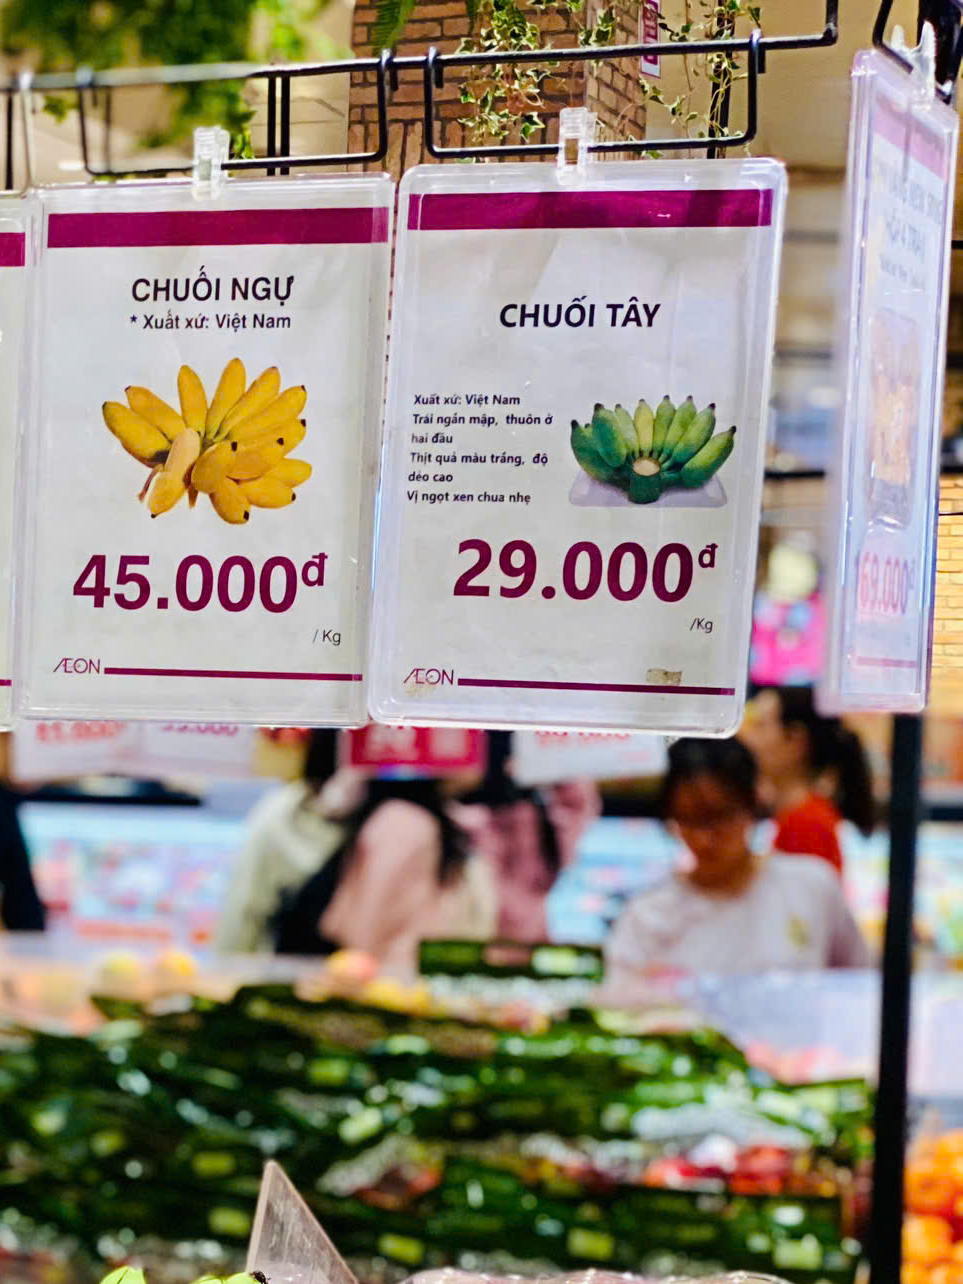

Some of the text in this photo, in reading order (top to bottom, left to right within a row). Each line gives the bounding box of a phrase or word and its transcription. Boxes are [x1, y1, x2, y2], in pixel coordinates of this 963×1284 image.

[132, 266, 294, 306] CHUỐI NGỰ
[499, 296, 661, 328] CHUỐI TÂY
[142, 309, 179, 329] Xuất
[185, 314, 209, 329] xứ:
[215, 313, 246, 333] Việt
[253, 314, 291, 328] Nam
[413, 394, 440, 405] Xuất
[465, 394, 489, 407] Việt
[492, 395, 521, 405] Nam
[413, 413, 433, 424] Trái
[469, 413, 498, 427] mập,
[505, 413, 541, 424] thuôn
[411, 433, 428, 444] hai
[410, 452, 432, 466] Thịt
[435, 452, 457, 466] quả
[461, 452, 487, 463] màu
[532, 453, 549, 466] độ
[432, 474, 454, 482] cao
[407, 491, 531, 505] Vị ngọt xen chua nhẹ
[453, 538, 718, 603] 29.000đ
[73, 553, 328, 613] 45.000đ
[689, 617, 713, 633] /Kg
[322, 630, 341, 645] Kg
